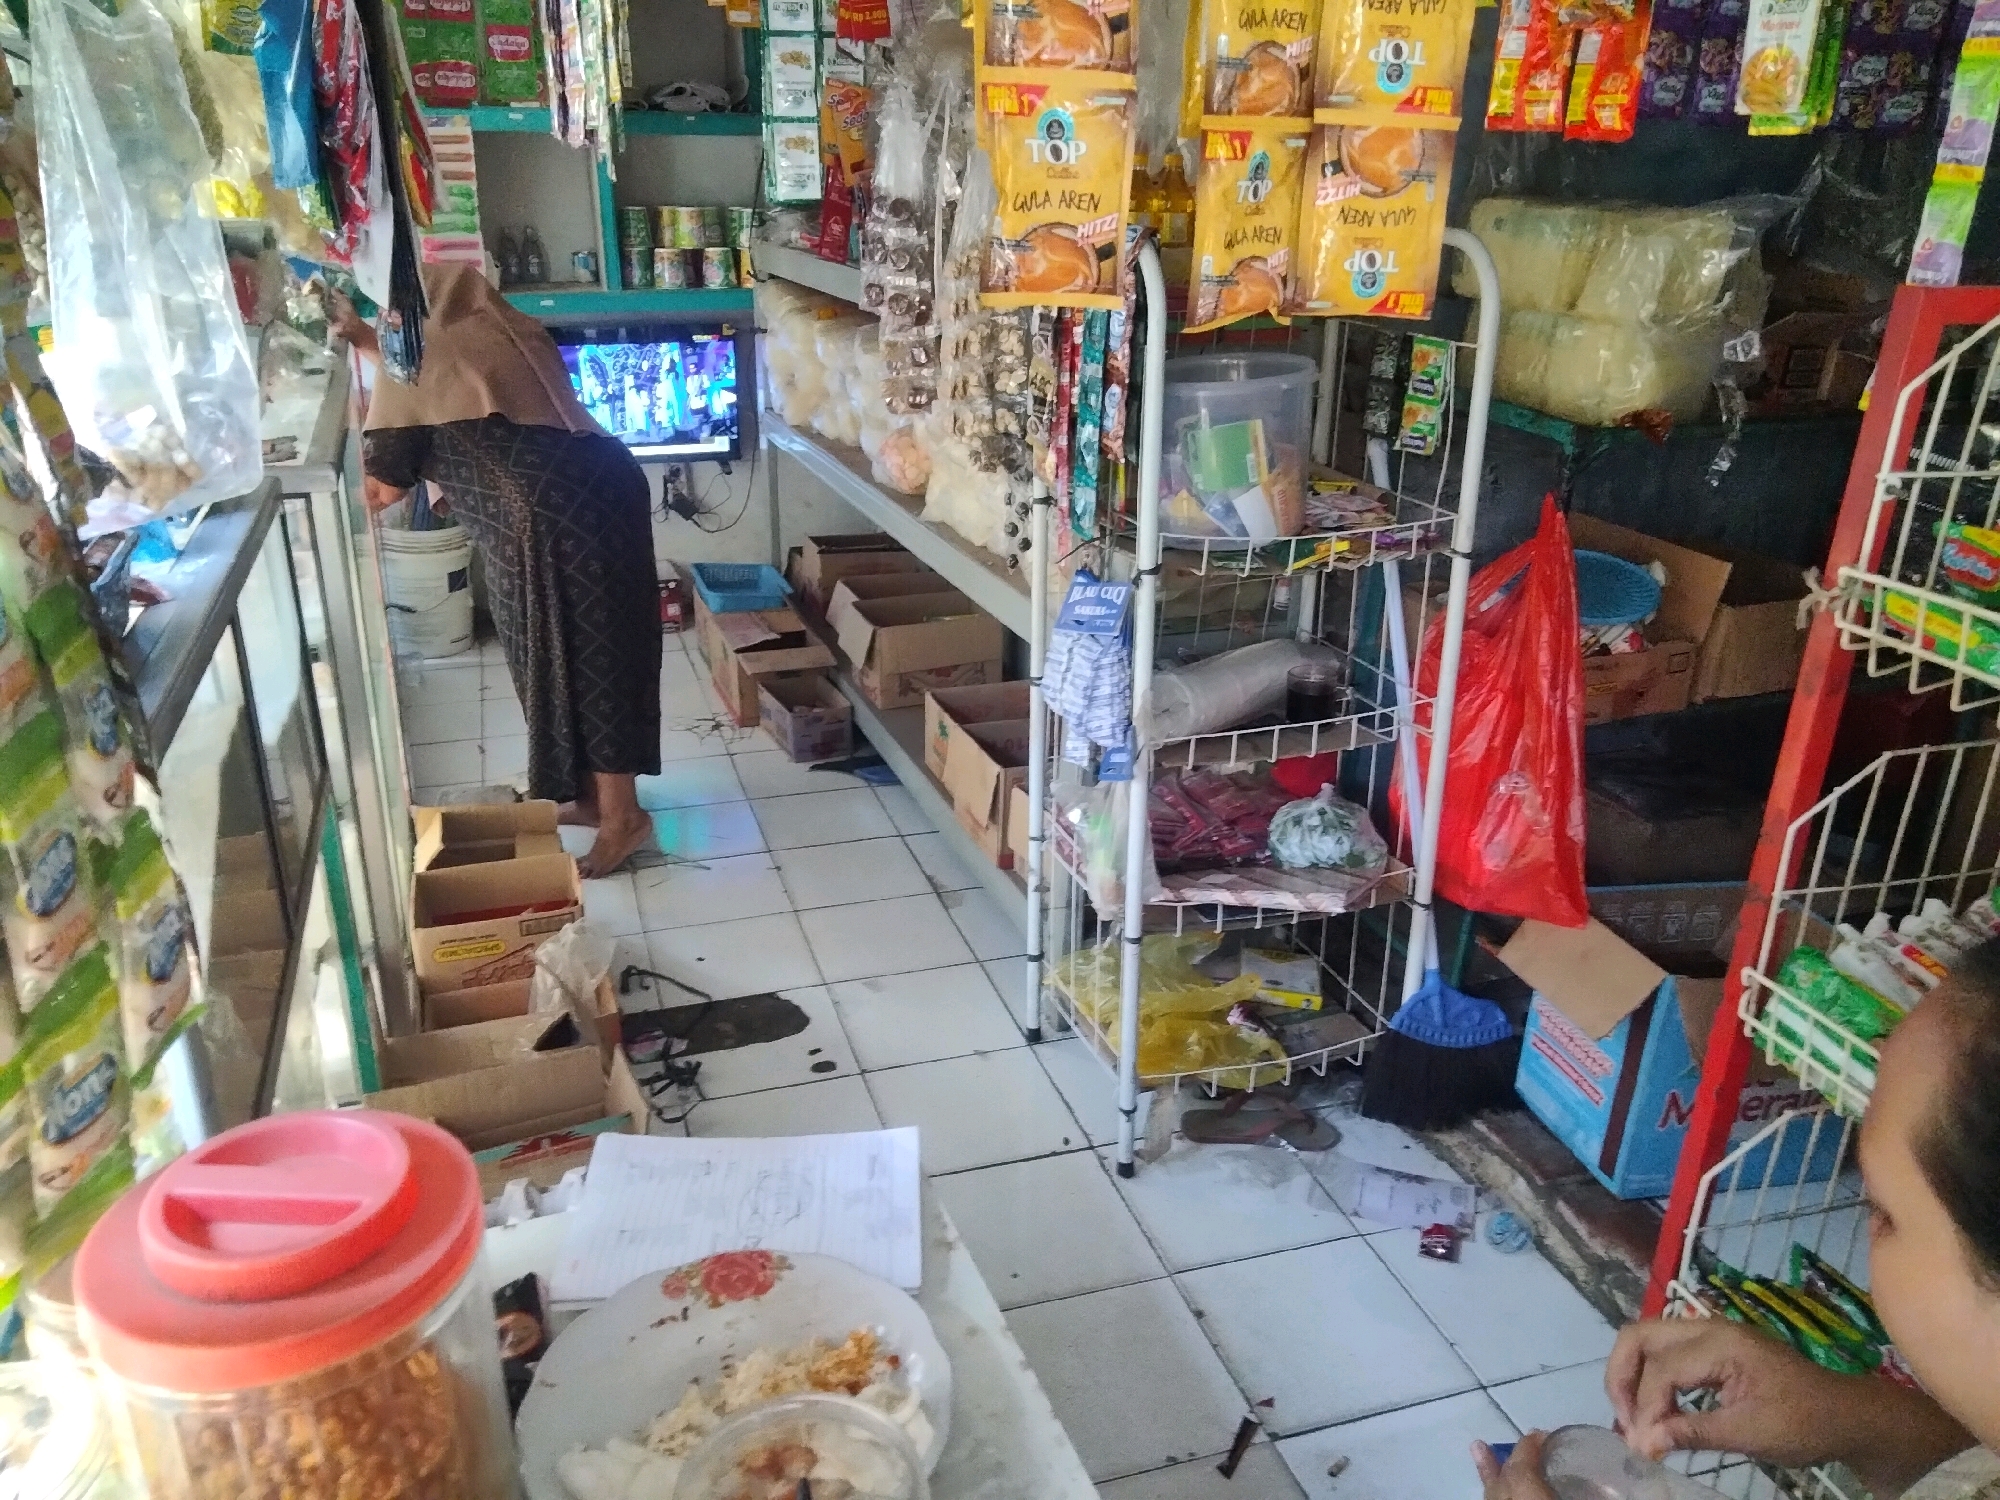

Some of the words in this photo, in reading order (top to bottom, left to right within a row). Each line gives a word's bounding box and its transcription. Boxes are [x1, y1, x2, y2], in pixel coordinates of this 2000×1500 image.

[1238, 8, 1269, 31] GULA
[1271, 8, 1309, 33] AREN
[1368, 38, 1427, 66] TOP
[1024, 138, 1088, 165] TOP
[1013, 190, 1052, 212] GULA
[1058, 190, 1102, 213] AREN
[1237, 179, 1273, 204] TOP
[1336, 204, 1376, 228] AREN
[1379, 205, 1417, 228] GULA
[1223, 227, 1249, 250] GULA
[1251, 225, 1283, 246] AREN
[1343, 250, 1400, 273] TOP
[1067, 586, 1100, 604] BLAU
[1100, 586, 1128, 605] CUCI
